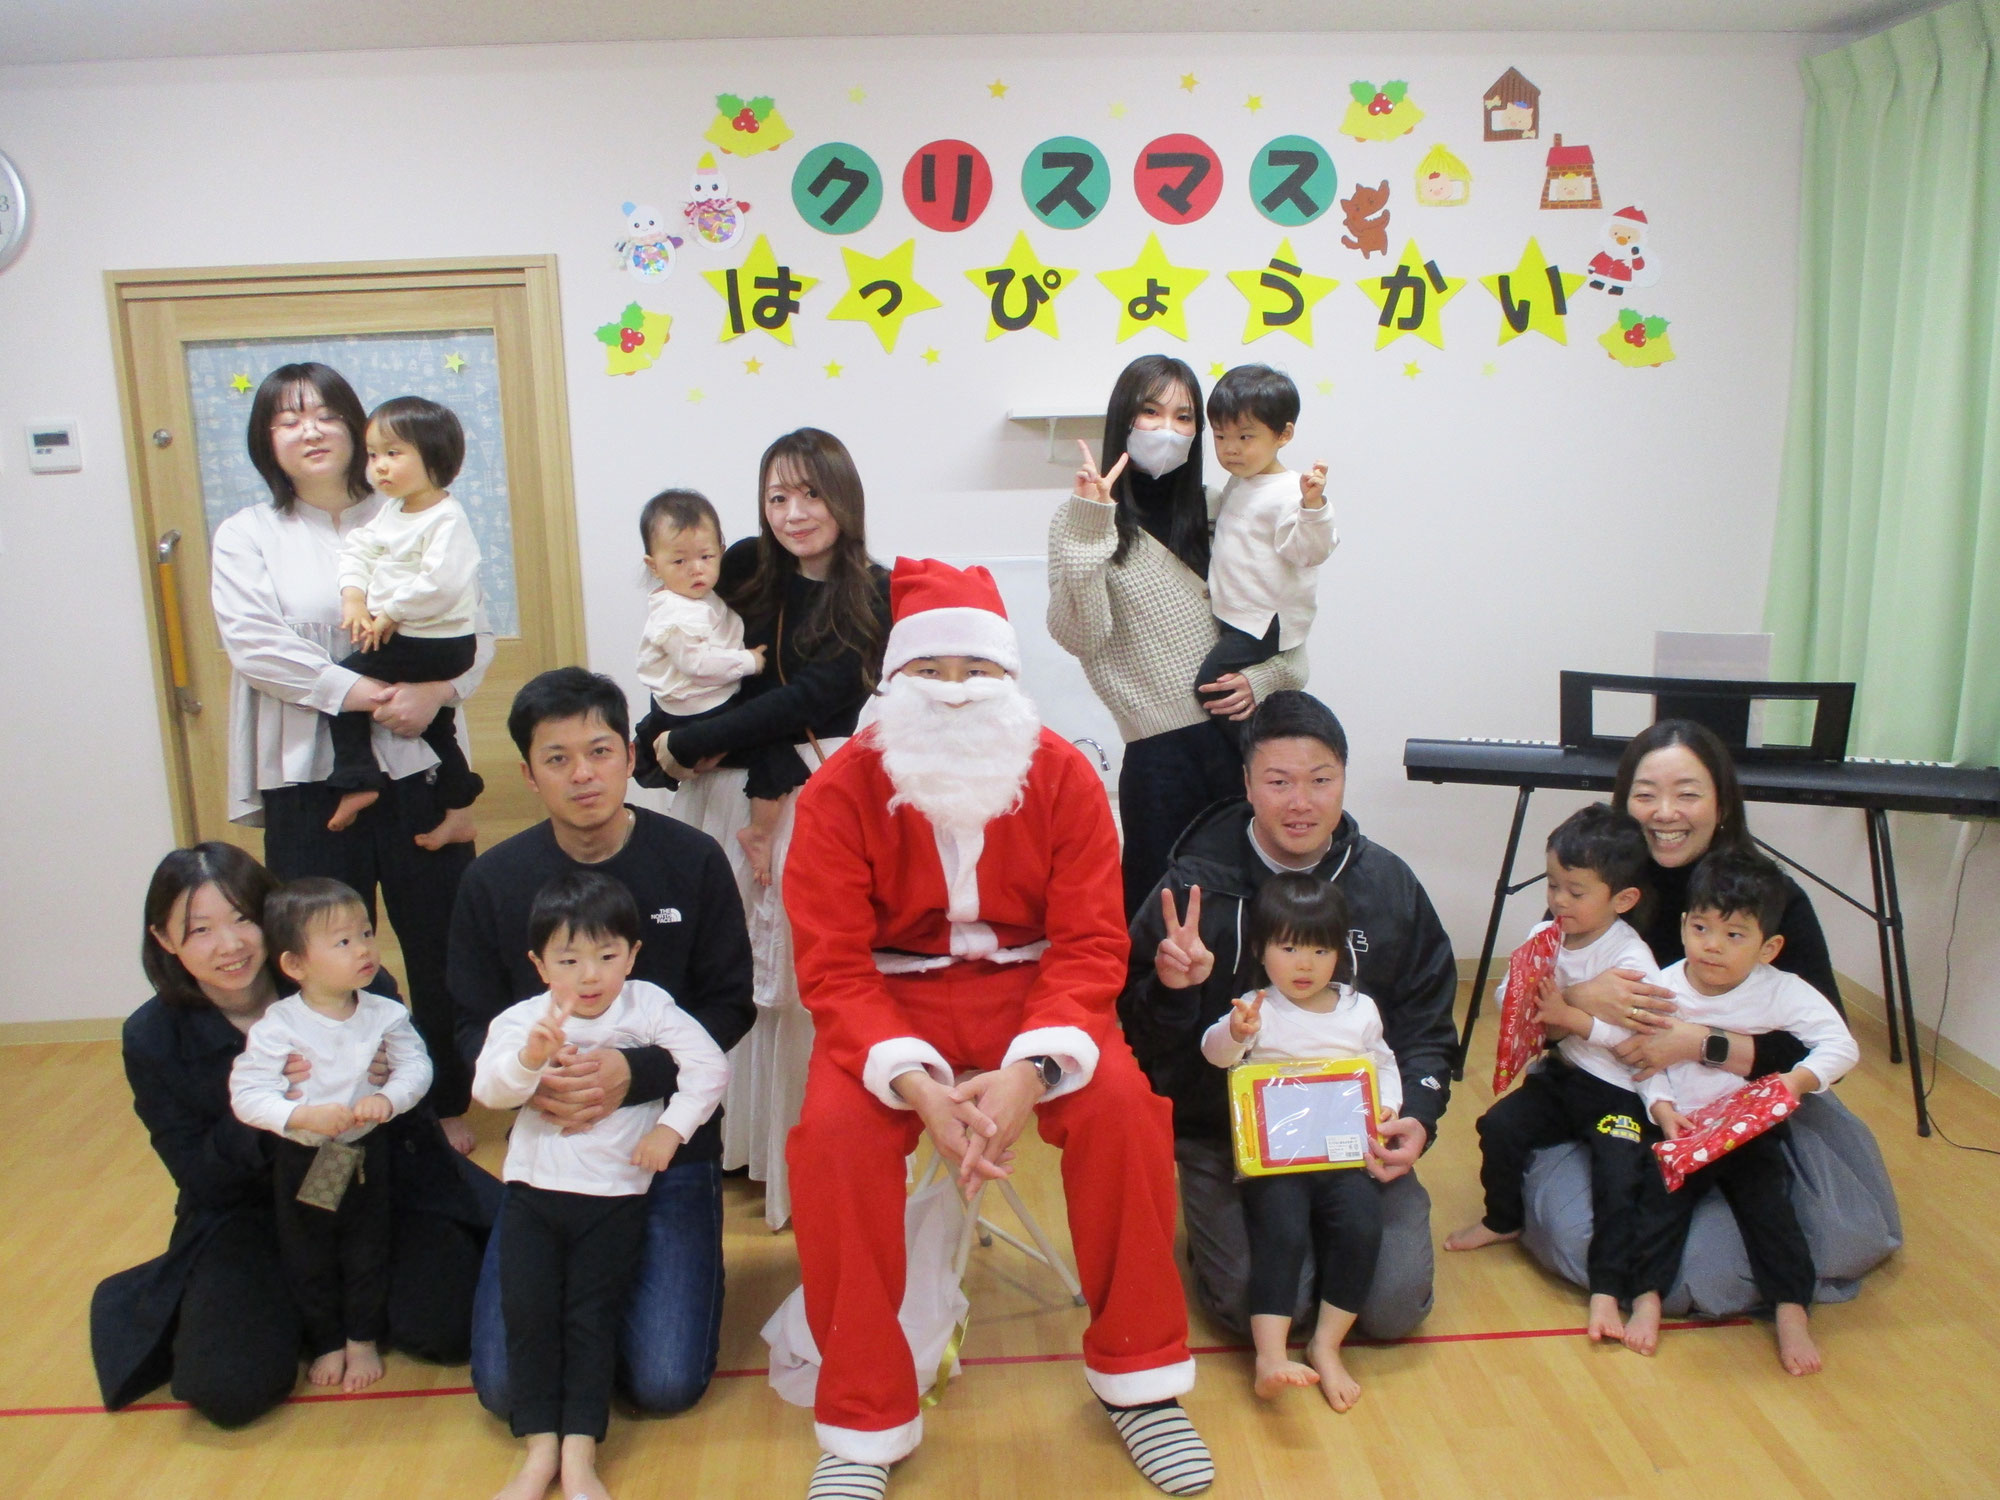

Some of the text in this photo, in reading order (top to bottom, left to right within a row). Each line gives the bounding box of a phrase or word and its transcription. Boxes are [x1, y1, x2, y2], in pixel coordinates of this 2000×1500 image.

[806, 149, 1320, 226] クリスマス
[725, 257, 1568, 333] はっぴょうかい
